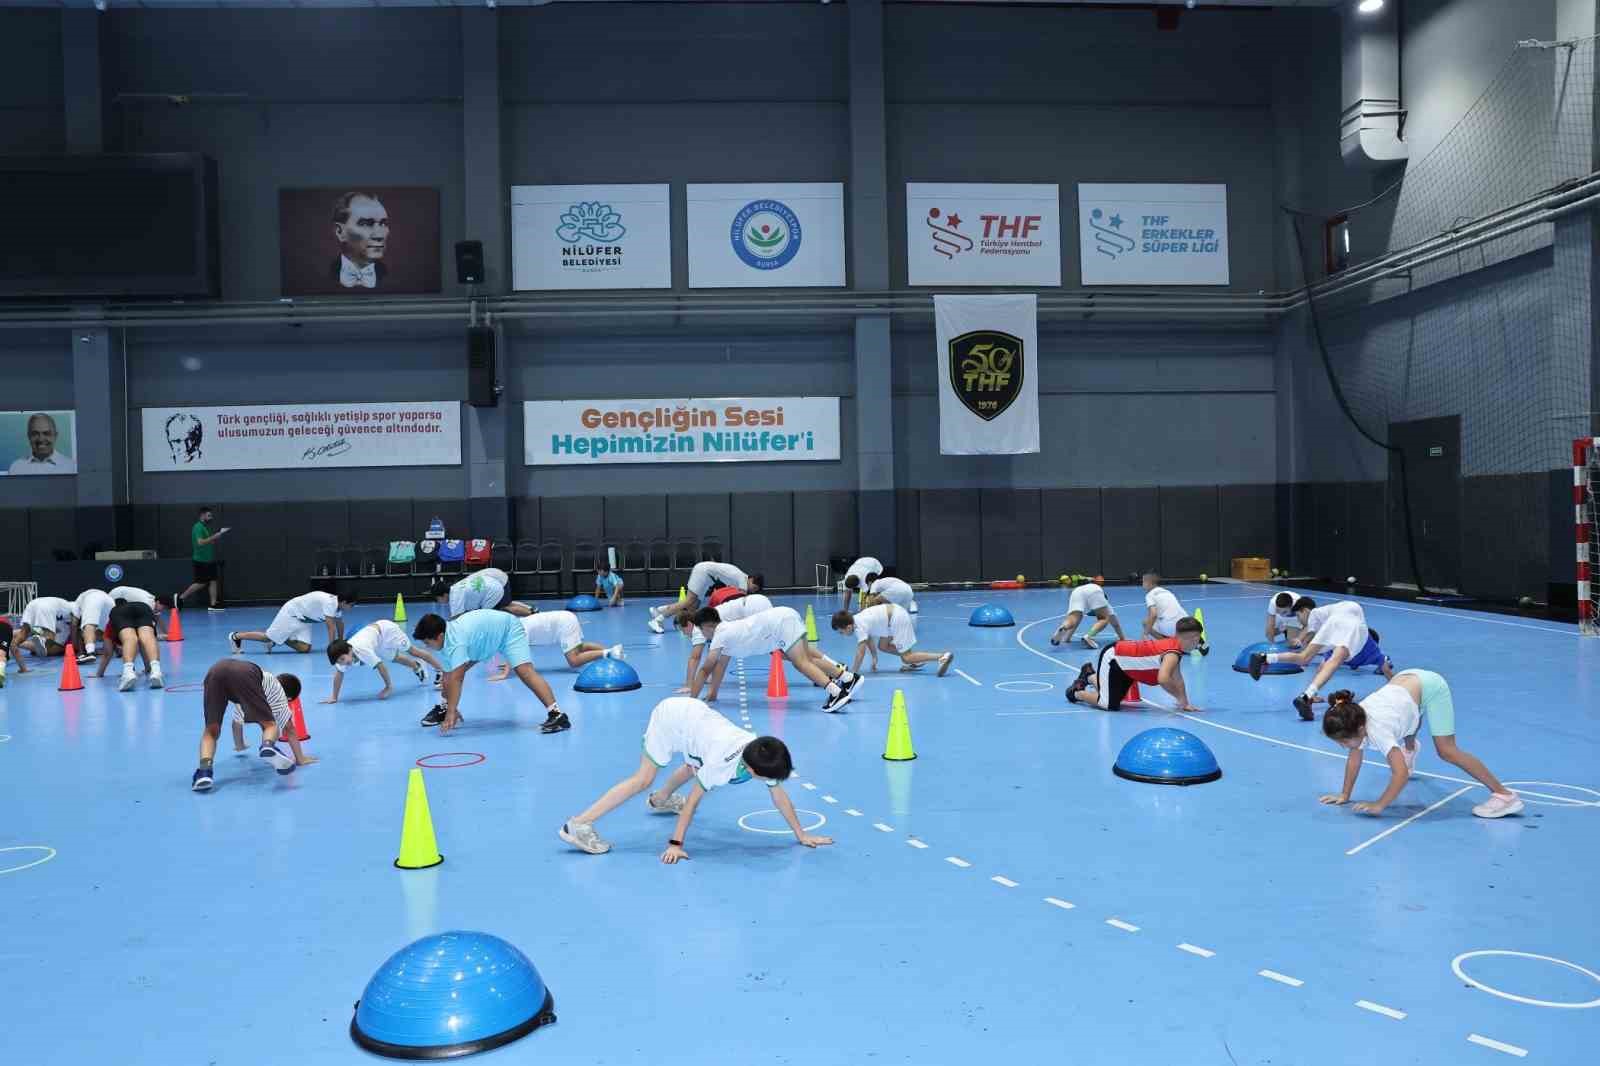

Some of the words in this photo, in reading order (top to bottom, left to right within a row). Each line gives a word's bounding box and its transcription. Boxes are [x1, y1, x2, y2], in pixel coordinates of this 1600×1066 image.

[979, 215, 1042, 238] THF
[1141, 215, 1169, 226] THF
[1142, 229, 1215, 239] ERKEKLER
[562, 245, 623, 256] NİLÜFER
[1142, 240, 1189, 253] SÜPER
[1191, 239, 1218, 253] LİGİ
[562, 258, 621, 266] BELEDİYESİ
[963, 372, 1010, 391] THF
[216, 414, 241, 425] Türk
[243, 412, 289, 426] gençliği,
[292, 411, 331, 424] sağlıklı
[334, 411, 370, 423] yetişip
[372, 412, 396, 423] spor
[399, 411, 442, 422] yaparsa
[581, 405, 716, 432] Gençliğin
[724, 406, 784, 426] Sesi
[217, 428, 285, 438] ulusumuzun
[287, 424, 334, 437] geleceği
[337, 424, 383, 436] güvence
[385, 423, 442, 433] altındadır.
[552, 433, 695, 458] Hepimizin
[703, 431, 814, 451] Nilüfer'i
